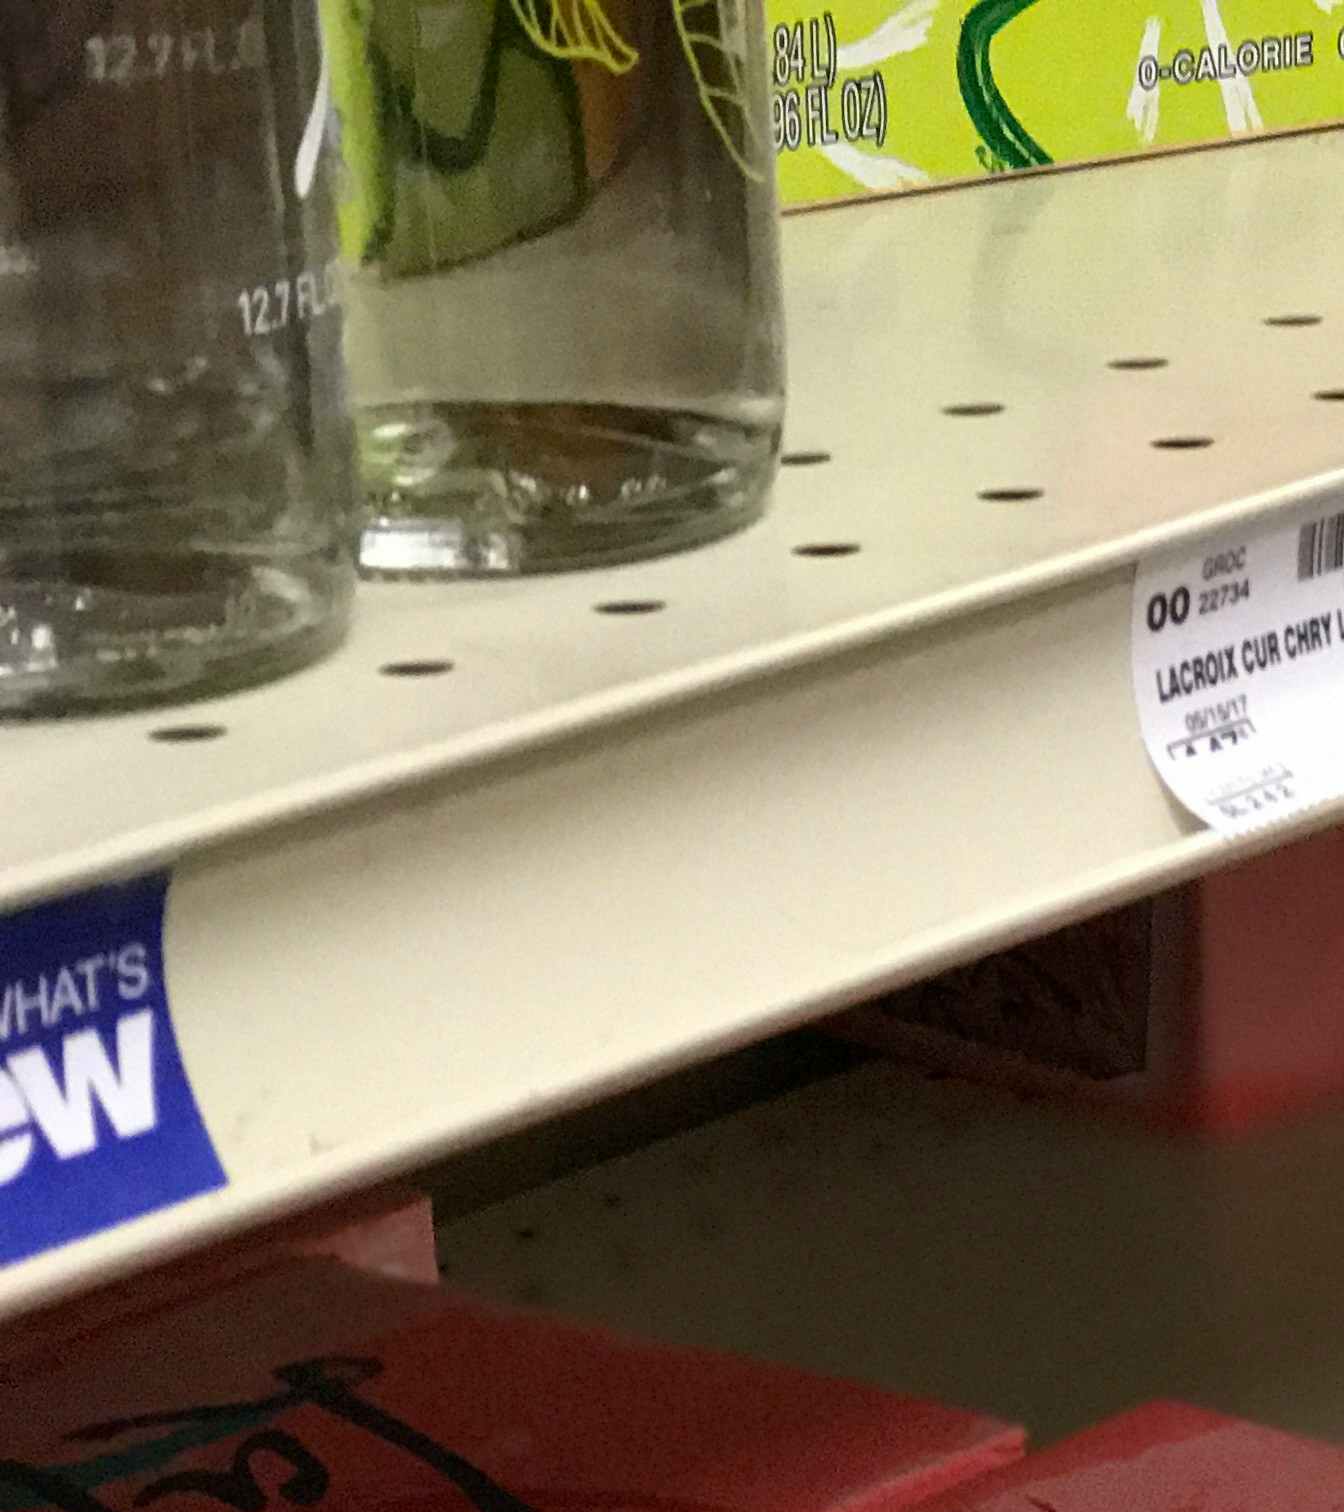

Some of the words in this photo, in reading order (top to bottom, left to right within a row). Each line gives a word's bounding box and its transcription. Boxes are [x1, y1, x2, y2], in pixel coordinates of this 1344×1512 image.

[810, 10, 837, 88] L)
[1138, 33, 1314, 91] 0-CALORIE
[805, 80, 839, 147] FL
[842, 70, 888, 148] OZ)
[1146, 586, 1191, 633] 00
[1156, 645, 1239, 704] LACROIX
[1241, 633, 1282, 675] CUR
[1284, 612, 1332, 660] CHRY
